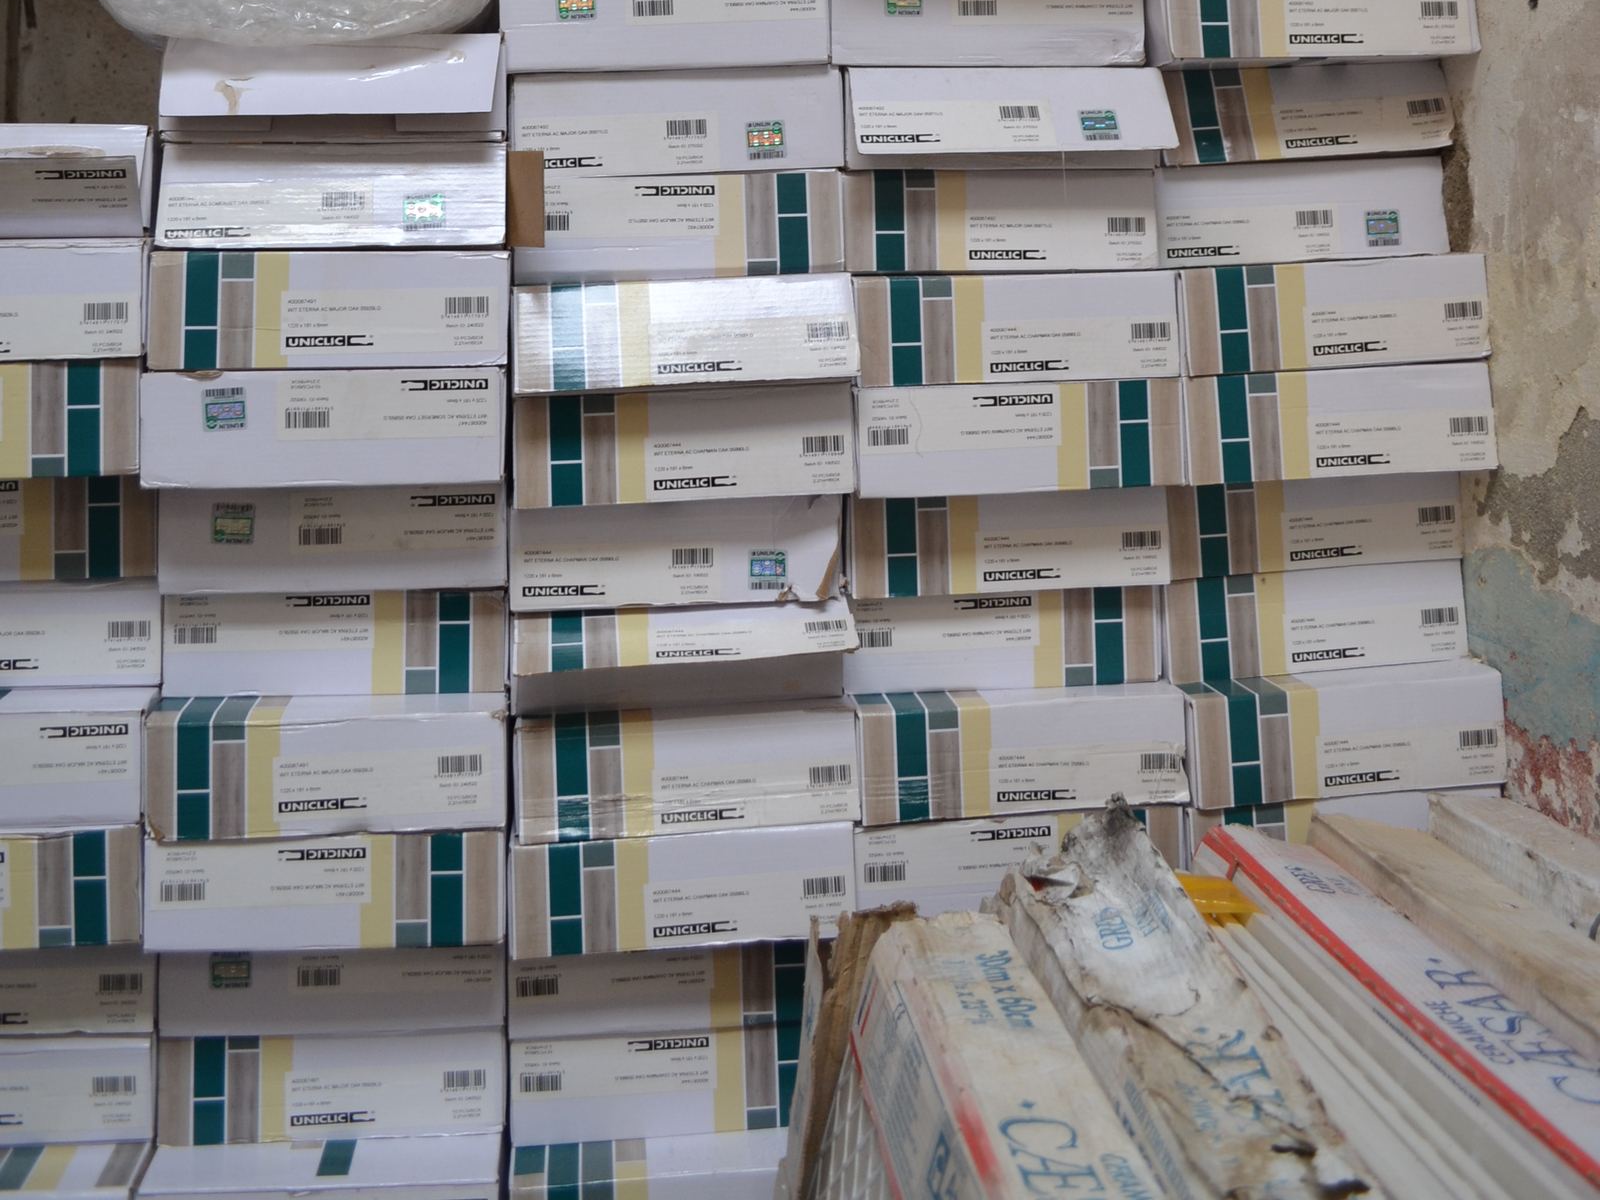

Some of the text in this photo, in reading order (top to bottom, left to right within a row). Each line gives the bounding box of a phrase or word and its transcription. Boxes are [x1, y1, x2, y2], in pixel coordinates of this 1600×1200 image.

[1291, 34, 1339, 43] UNICLIC
[862, 134, 914, 143] UNICLIC
[1286, 137, 1334, 148] UNICLIC
[542, 158, 578, 170] ICLIC
[64, 168, 126, 179] UNICLIC
[660, 185, 714, 196] UNICLIC
[970, 249, 1022, 260] UNICLIC
[1168, 247, 1216, 258] UNICLIC
[287, 336, 345, 347] UNICLIC
[1314, 344, 1362, 355] UNICLIC
[660, 362, 714, 373] UNICLIC
[991, 361, 1043, 372] UNICLIC
[429, 379, 487, 390] UNICLIC
[998, 394, 1052, 405] UNICLIC
[1318, 456, 1366, 467] UNICLIC
[655, 478, 709, 489] UNICLIC
[439, 494, 493, 505] UNICLIC
[1291, 549, 1339, 560] UNICLIC
[984, 570, 1036, 581] UNICLIC
[524, 586, 578, 597] UNICLIC
[314, 595, 368, 606] UNICLIC
[979, 597, 1031, 608] UNICLIC
[656, 649, 713, 658] UNICLIC
[1293, 650, 1341, 661] UNICLIC
[69, 724, 127, 737] UNICLIC
[1324, 773, 1376, 786] UNICLIC
[998, 791, 1050, 800] UNICLIC
[280, 799, 338, 812] UNICLIC
[663, 811, 717, 822] UNICLIC
[996, 826, 1050, 839] UNICLIC
[307, 848, 365, 859] UNICLIC
[655, 924, 709, 937] UNICLIC
[1424, 999, 1515, 1066] CERAMICHE
[654, 1038, 708, 1049] UNICLIC
[293, 1114, 347, 1125] UNICLIC
